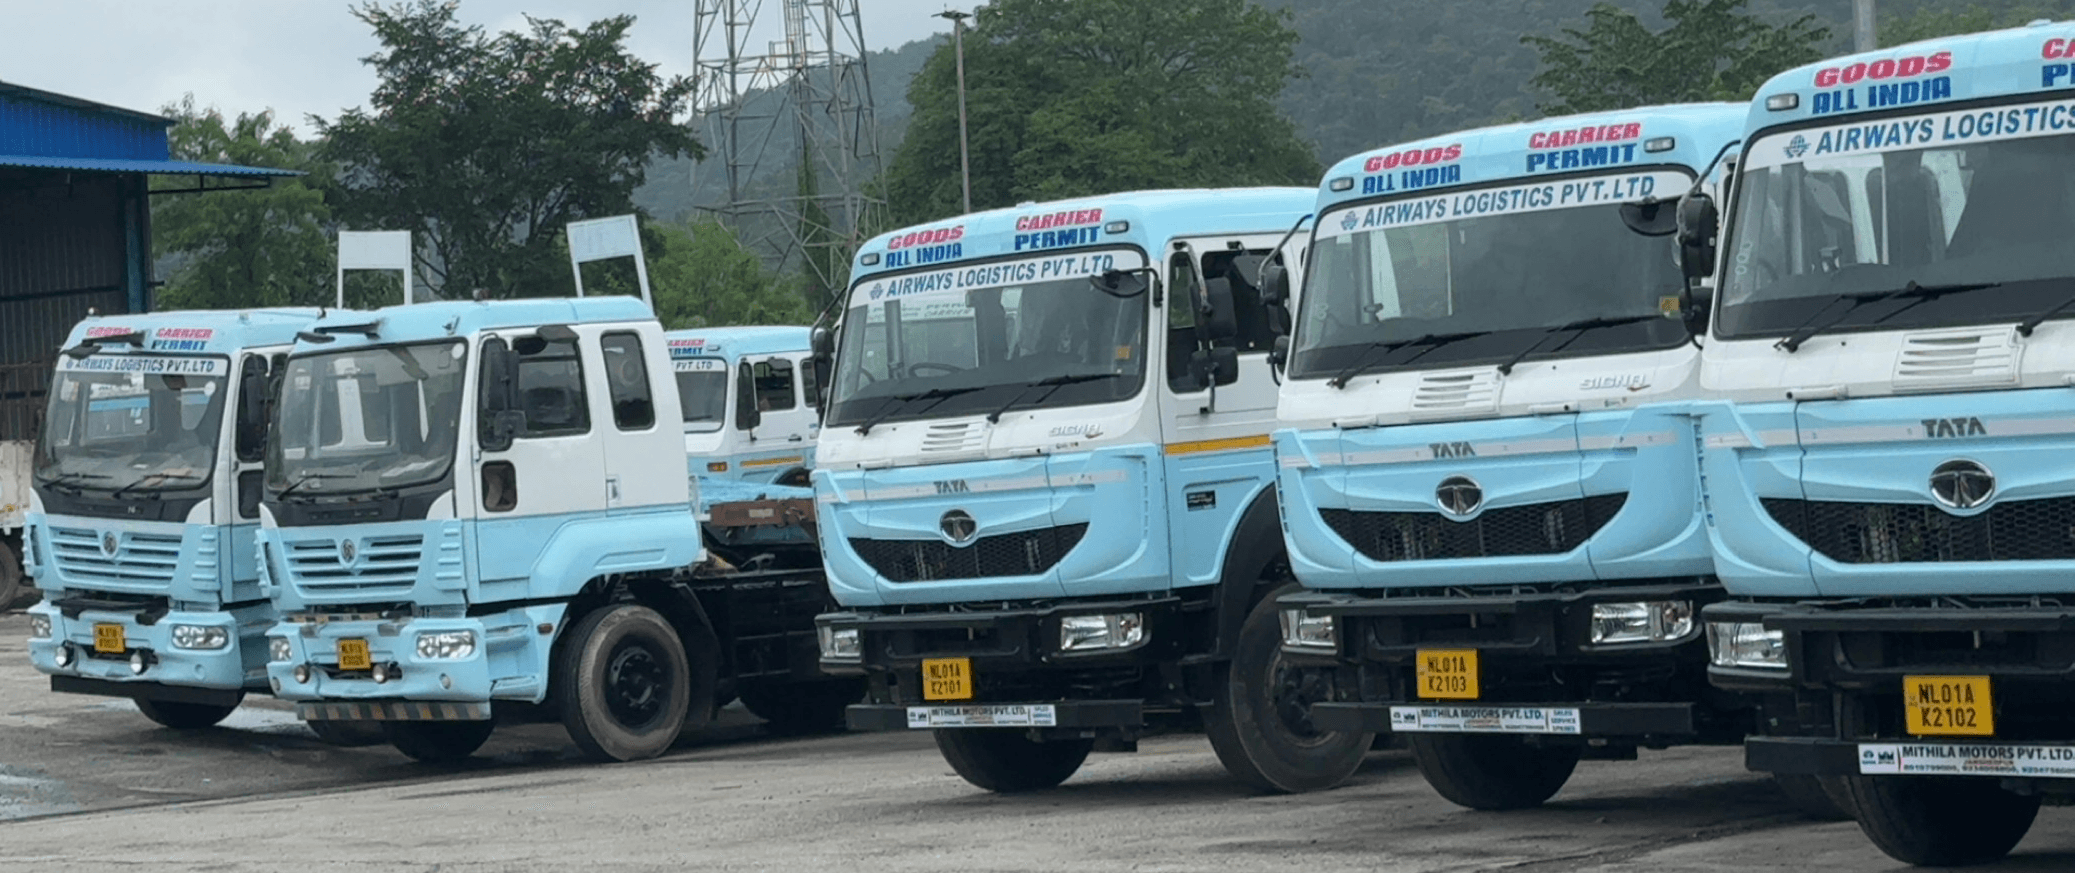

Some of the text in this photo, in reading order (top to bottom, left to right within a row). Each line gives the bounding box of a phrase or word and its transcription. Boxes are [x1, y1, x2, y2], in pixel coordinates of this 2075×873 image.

[1815, 52, 1952, 88] GOODS
[1812, 88, 1858, 115] ALL
[1868, 76, 1951, 107] INDIA
[1364, 122, 1641, 172] GOODS CARRIER
[1815, 119, 1934, 155] AIRWAYS
[1362, 143, 1637, 194] ALL INDIA PERMIT
[1362, 198, 1447, 228] AIRWAYS
[1453, 186, 1554, 216] LOGISTICS
[888, 209, 1102, 250] GOODS CARRIER
[885, 226, 1100, 268] ALL INDIA PERMIT
[887, 273, 953, 297] AIRWAYS
[957, 263, 1036, 288] LOGISTICS
[156, 328, 214, 339] CARRIER
[151, 340, 207, 350] PERMIT
[75, 359, 113, 370] AIRWAYS
[115, 359, 165, 372] LOGISTICS
[1921, 417, 1987, 438] TATA
[1429, 442, 1476, 458] TATA
[933, 479, 971, 494] TATA
[930, 663, 961, 679] NL01A
[1427, 656, 1467, 673] NL01A
[931, 680, 961, 695] K2101
[1428, 675, 1467, 692] K2103
[1919, 683, 1975, 704] NL01A
[1421, 708, 1459, 718] MITHILA
[1461, 708, 1500, 718] MOTORS
[1524, 709, 1544, 719] LTD.
[1921, 707, 1977, 728] K2102
[1902, 746, 1956, 758] MITHILA
[1959, 746, 2015, 759] MOTORS
[2017, 747, 2047, 760] PVT.
